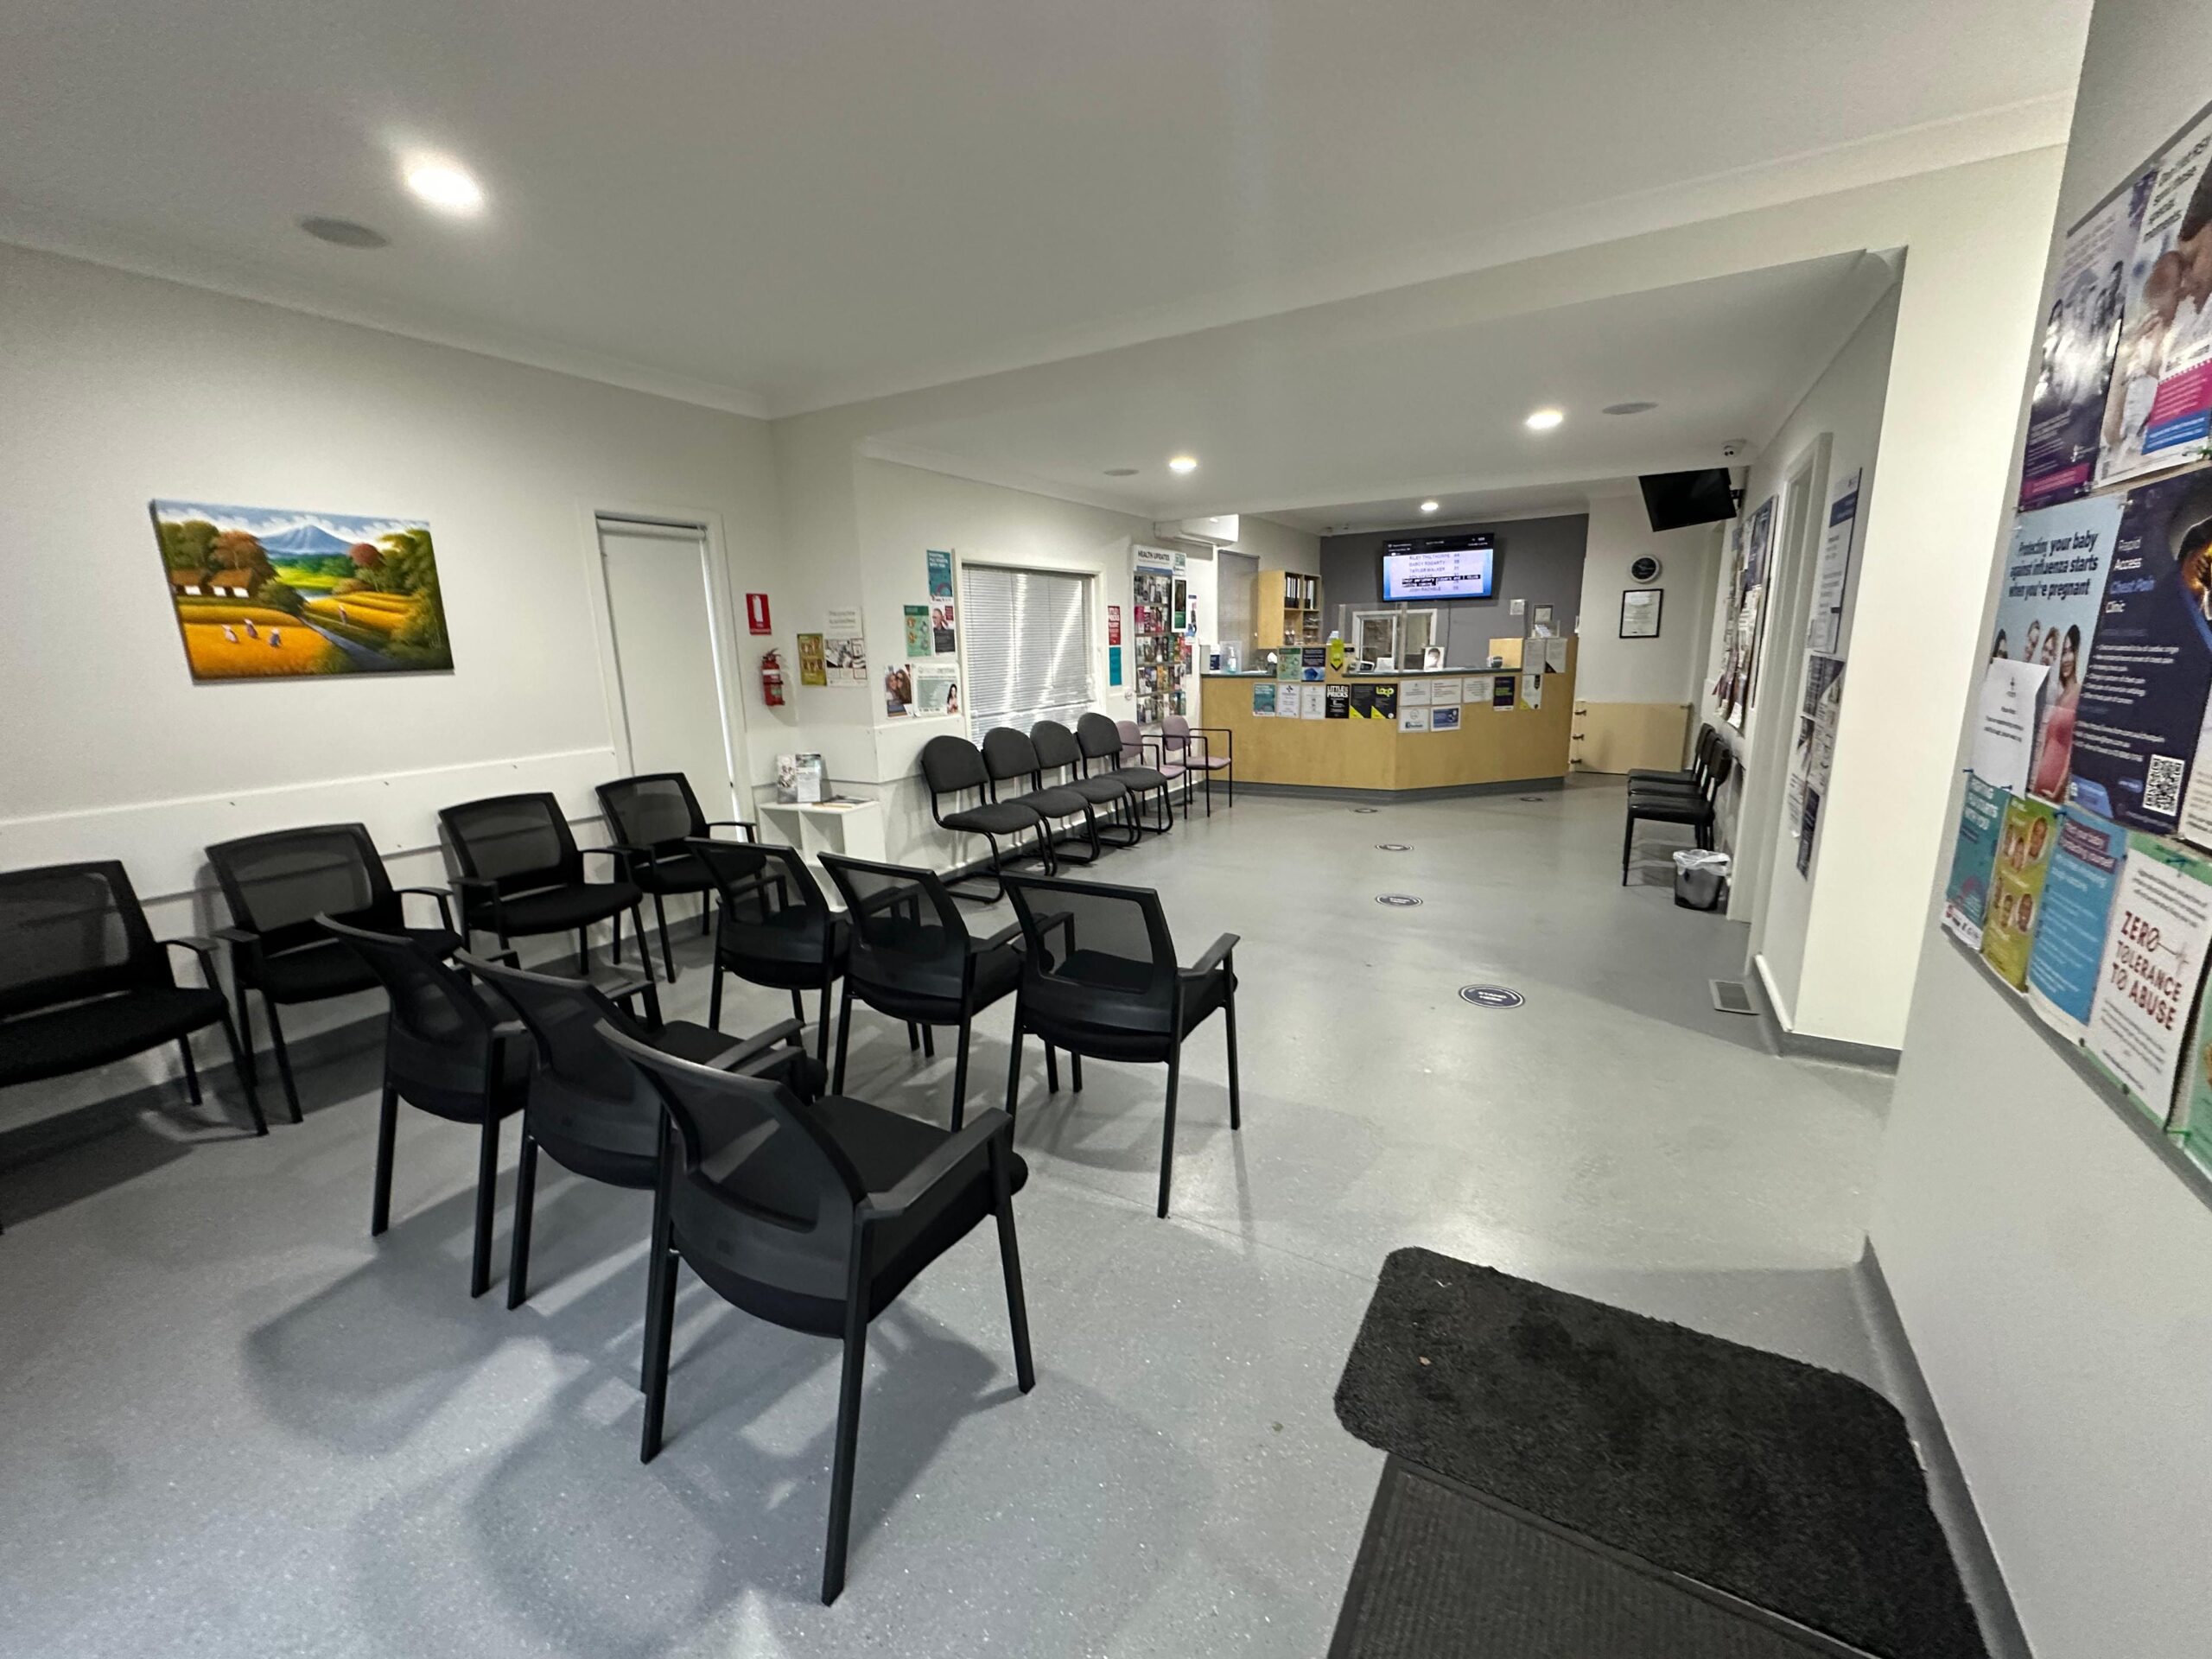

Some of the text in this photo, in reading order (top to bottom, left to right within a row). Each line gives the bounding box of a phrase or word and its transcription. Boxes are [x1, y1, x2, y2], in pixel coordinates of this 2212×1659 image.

[1138, 550, 1154, 559] HEALTH
[2050, 537, 2072, 556] your
[2073, 530, 2099, 552] baby
[2032, 558, 2069, 575] influenza
[2069, 554, 2098, 572] starts
[2113, 557, 2143, 570] Access
[2047, 578, 2090, 601] pregnant
[2121, 910, 2159, 952] ZERO
[2116, 940, 2182, 1001] TOLERANCE
[2111, 963, 2177, 1031] TO ABUSE
